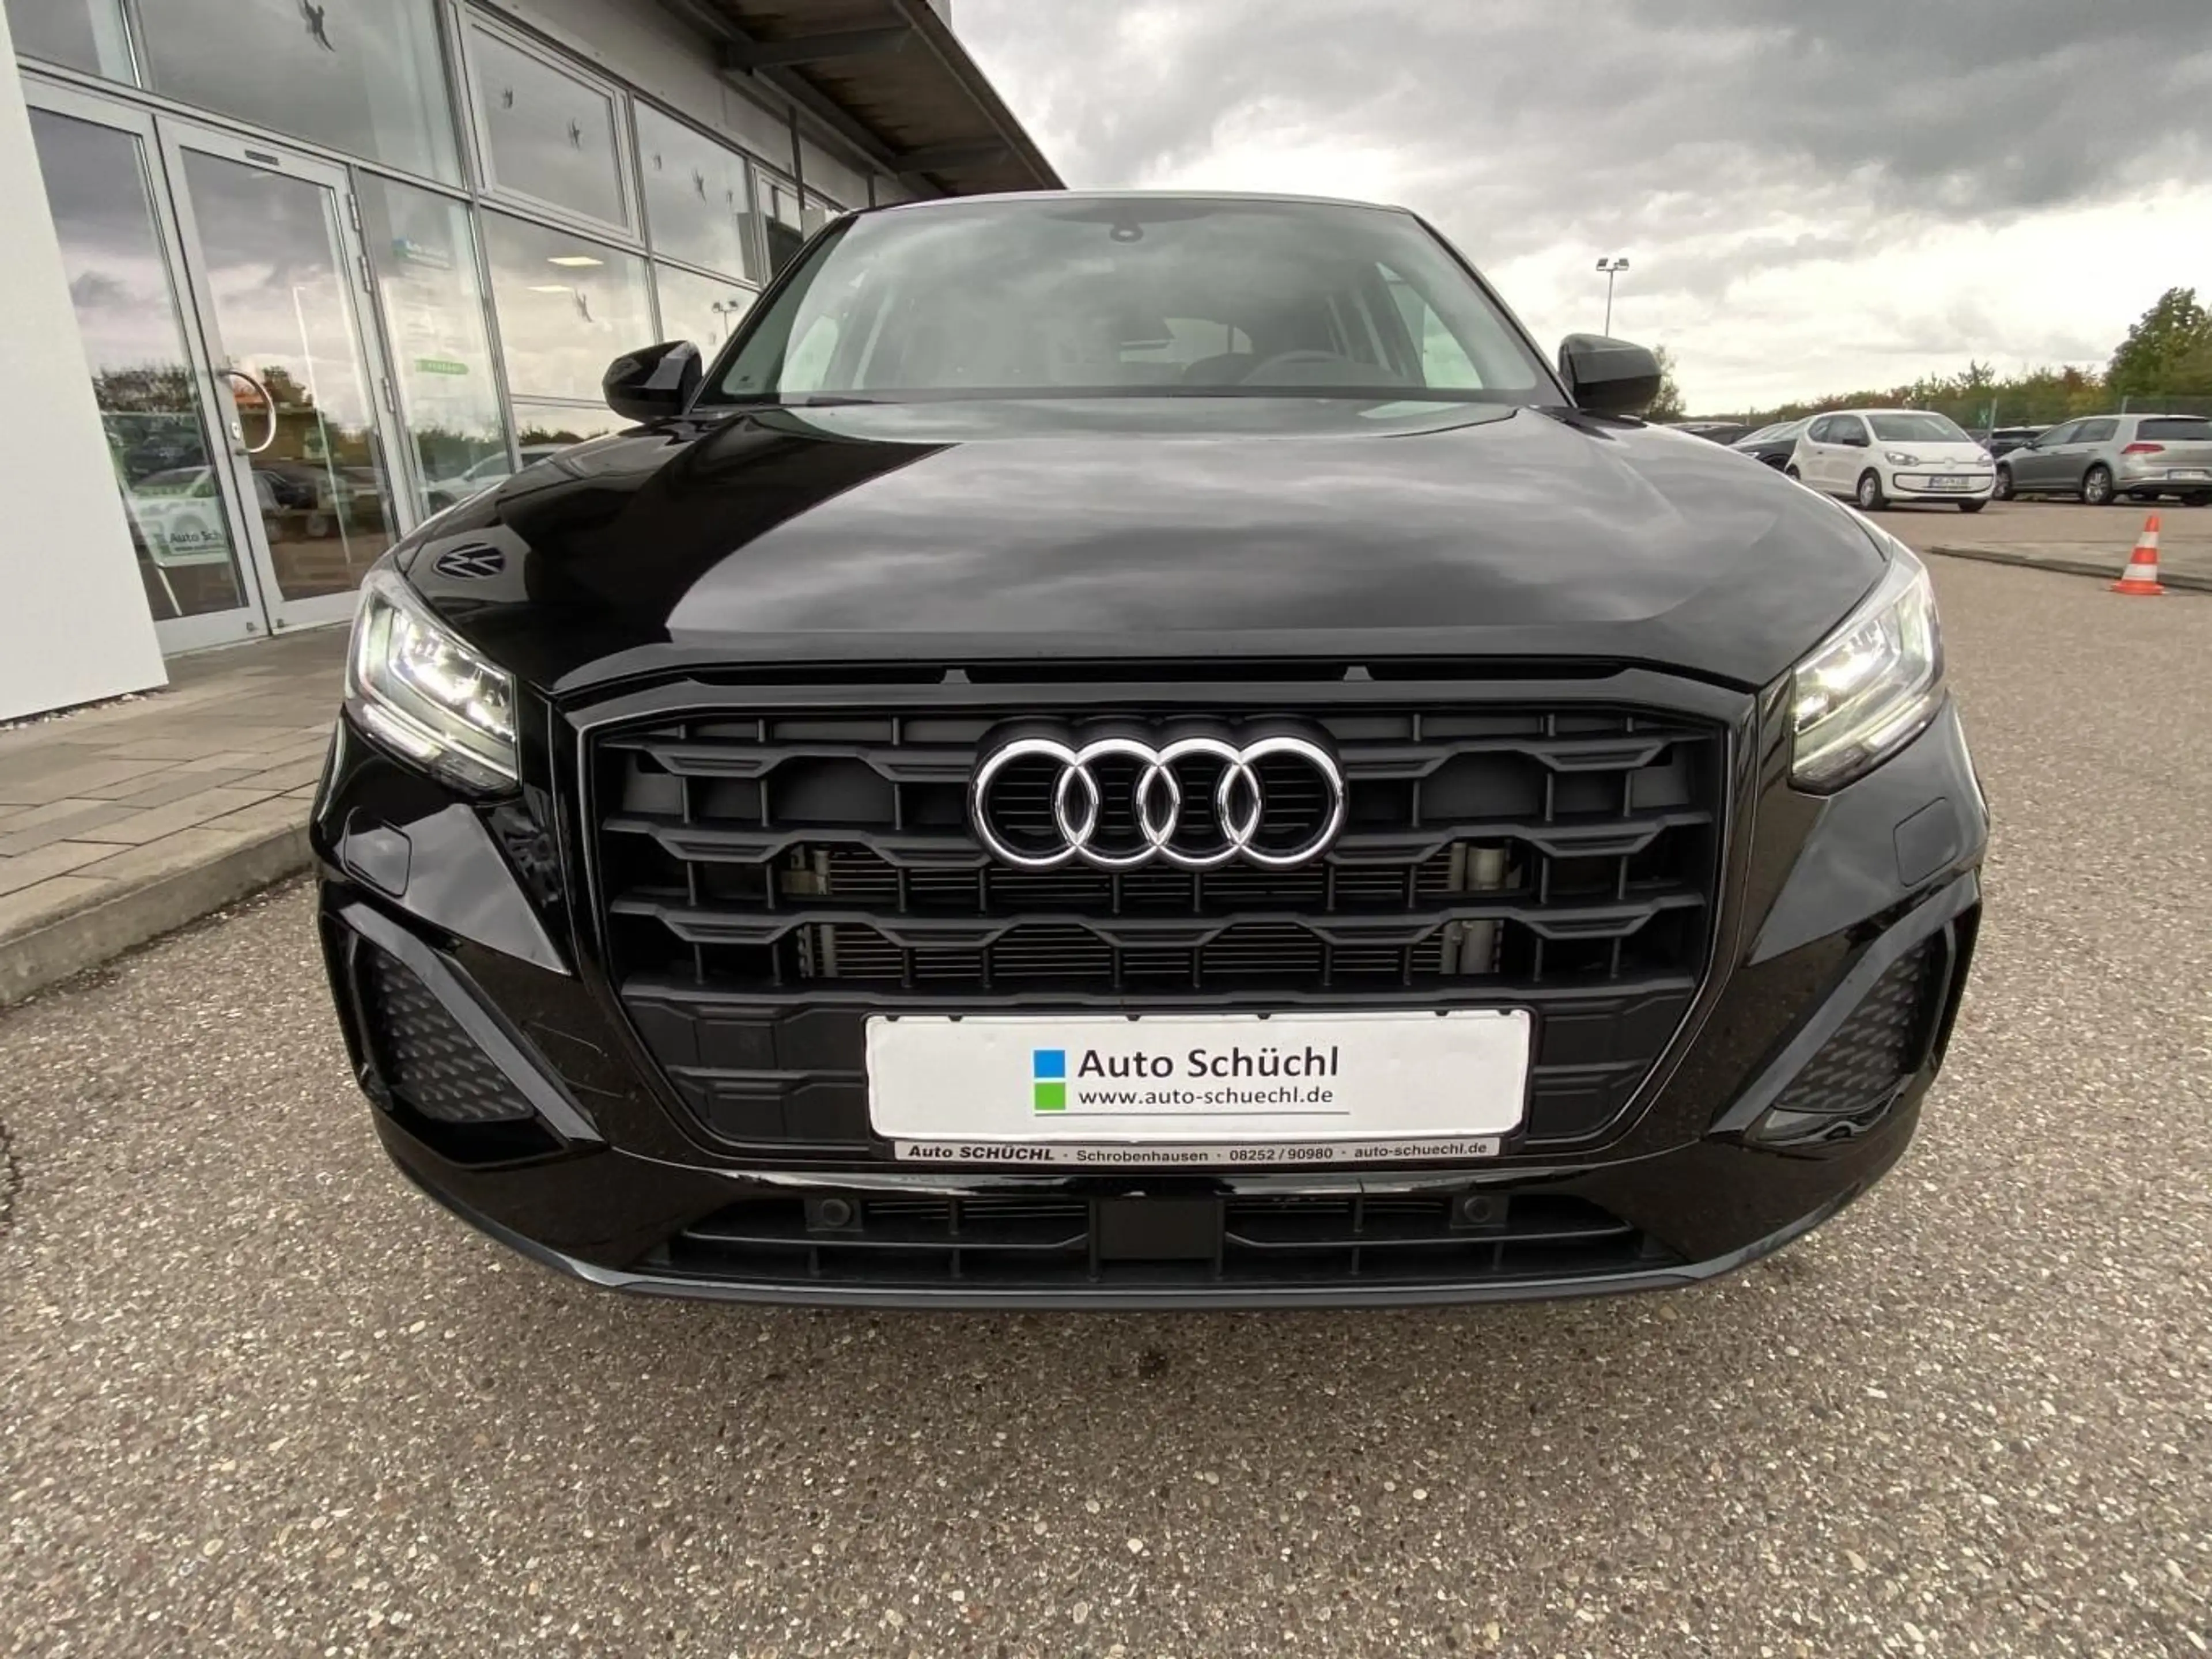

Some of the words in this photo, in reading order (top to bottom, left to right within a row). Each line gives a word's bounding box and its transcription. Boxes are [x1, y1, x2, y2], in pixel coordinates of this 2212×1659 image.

[169, 531, 200, 543] Auto
[1077, 1049, 1174, 1078] Auto
[1186, 1046, 1338, 1078] Schüchl
[1079, 1086, 1334, 1105] www.auto-schuechl.de
[908, 1145, 954, 1158] Auto
[959, 1145, 1055, 1161] SCHÜCHL
[1076, 1149, 1209, 1162] Schrobenhausen
[1354, 1142, 1488, 1159] auto-schuechl.de
